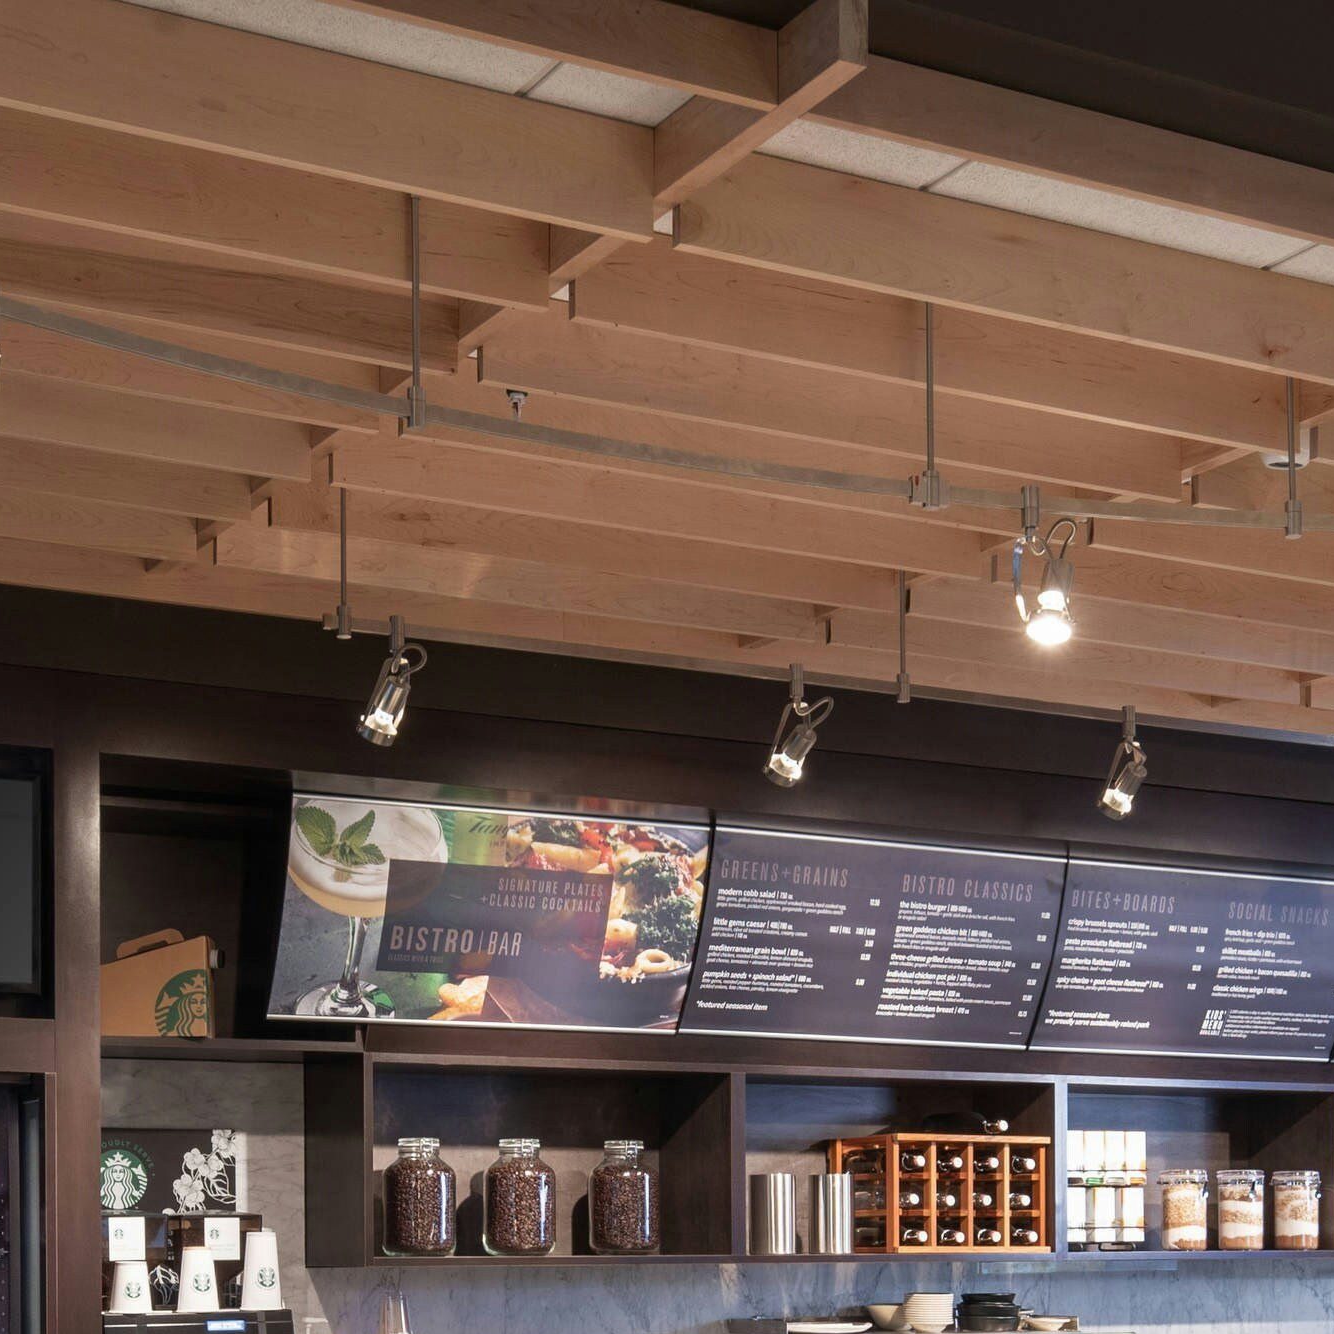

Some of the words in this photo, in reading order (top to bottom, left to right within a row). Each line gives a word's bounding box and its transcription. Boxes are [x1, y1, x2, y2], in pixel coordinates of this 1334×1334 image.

[499, 878, 558, 894] SIGNATURE
[564, 883, 603, 897] PLATES
[718, 888, 742, 896] modern
[760, 890, 776, 898] salad
[902, 874, 955, 896] BISTRO
[964, 879, 1033, 902] CLASSICS
[481, 895, 535, 910] +CLASSIC
[541, 896, 601, 913] COCKTAILS
[900, 901, 909, 909] the
[911, 901, 927, 910] bistro
[928, 902, 947, 912] burger
[1228, 902, 1272, 921] SOCIAL
[1281, 905, 1328, 926] SNACKS
[729, 919, 745, 928] gems
[937, 927, 958, 935] chicken
[390, 925, 474, 954] BISTRO
[488, 930, 522, 956] BAR
[709, 944, 753, 953] mediterranean
[754, 947, 770, 956] grain
[771, 947, 786, 955] bowl
[945, 956, 963, 964] cheese
[988, 960, 1001, 968] soup
[703, 970, 729, 979] pumpkin
[731, 971, 747, 979] seeds
[753, 973, 775, 981] spinach
[915, 971, 936, 980] chicken
[911, 988, 928, 996] baked
[725, 1001, 753, 1010] seasonal
[754, 1002, 767, 1010] item
[900, 1004, 913, 1012] herb
[914, 1004, 936, 1013] chicken
[1202, 1020, 1223, 1030] MENU
[102, 1140, 130, 1149] OUDLY
[134, 1144, 155, 1168] SERVE
